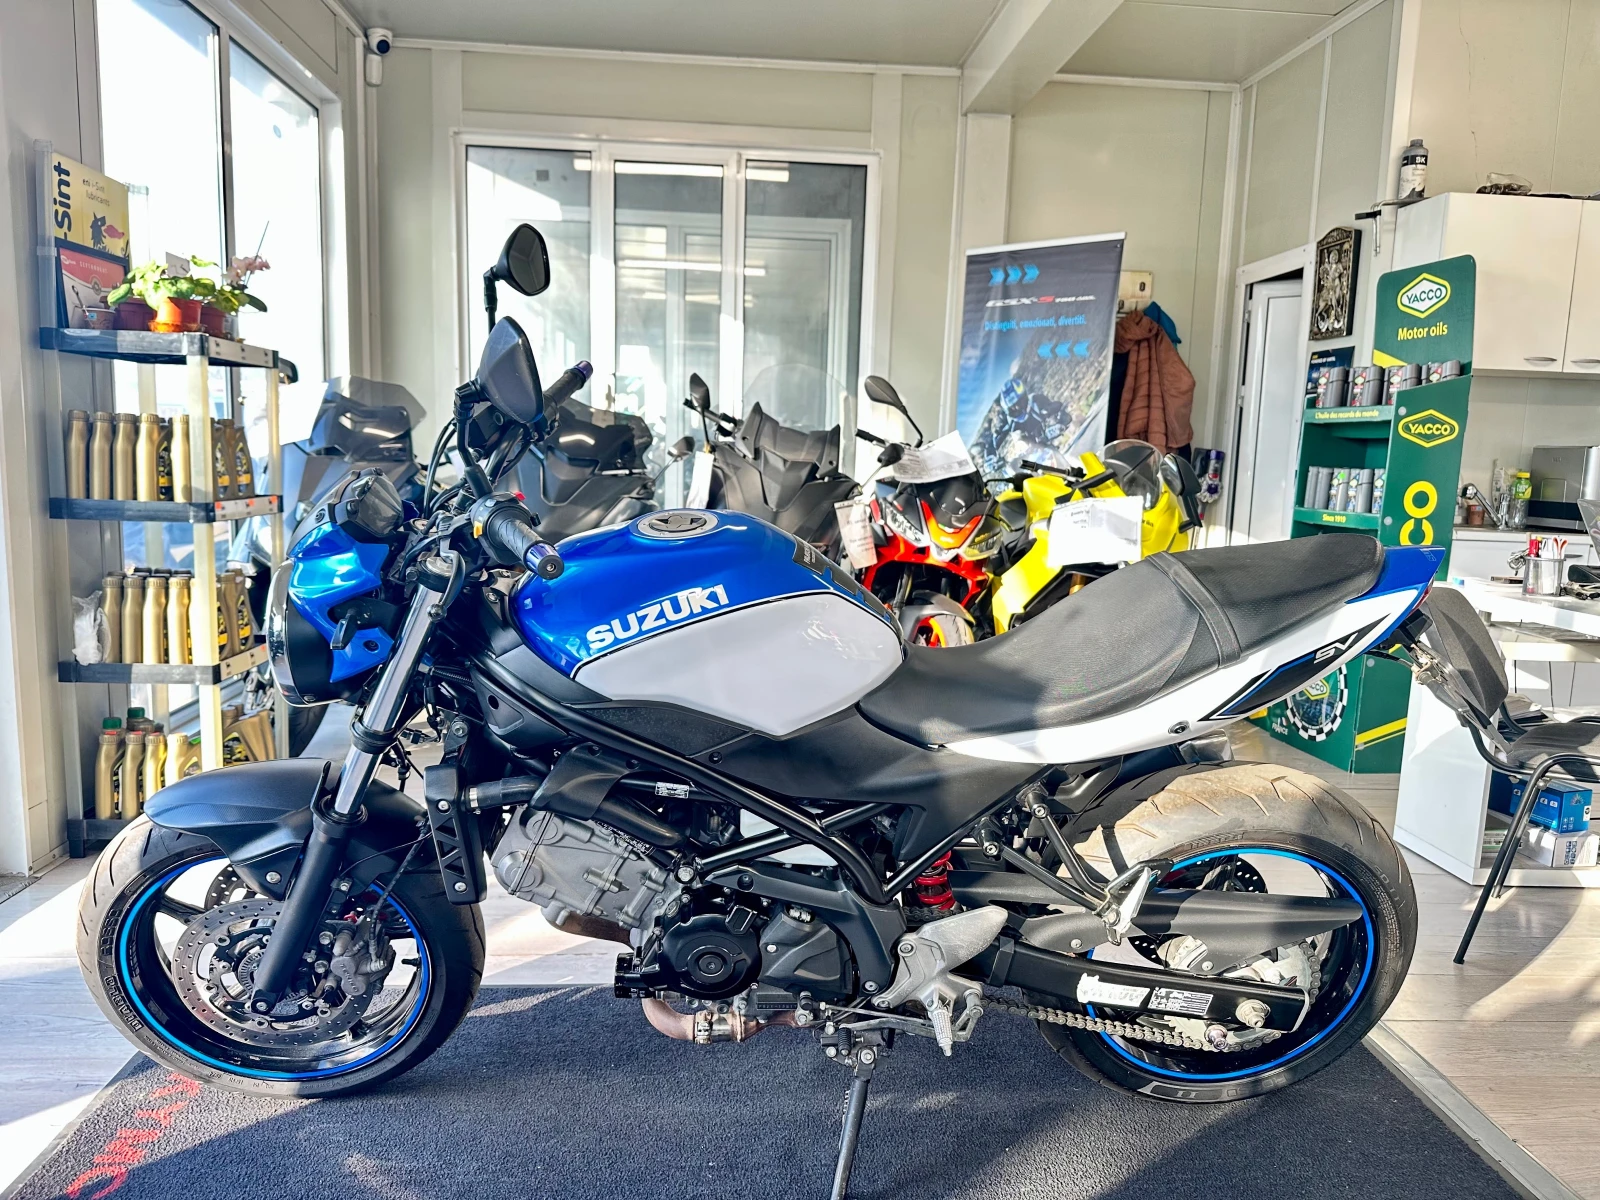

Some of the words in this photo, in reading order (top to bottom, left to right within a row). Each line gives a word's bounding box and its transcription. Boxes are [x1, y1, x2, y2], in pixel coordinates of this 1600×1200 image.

[1406, 287, 1443, 304] YACCO
[1397, 326, 1429, 341] Motor
[1429, 321, 1448, 337] oils
[1408, 423, 1451, 435] YACCO
[586, 584, 729, 649] SUZUKI
